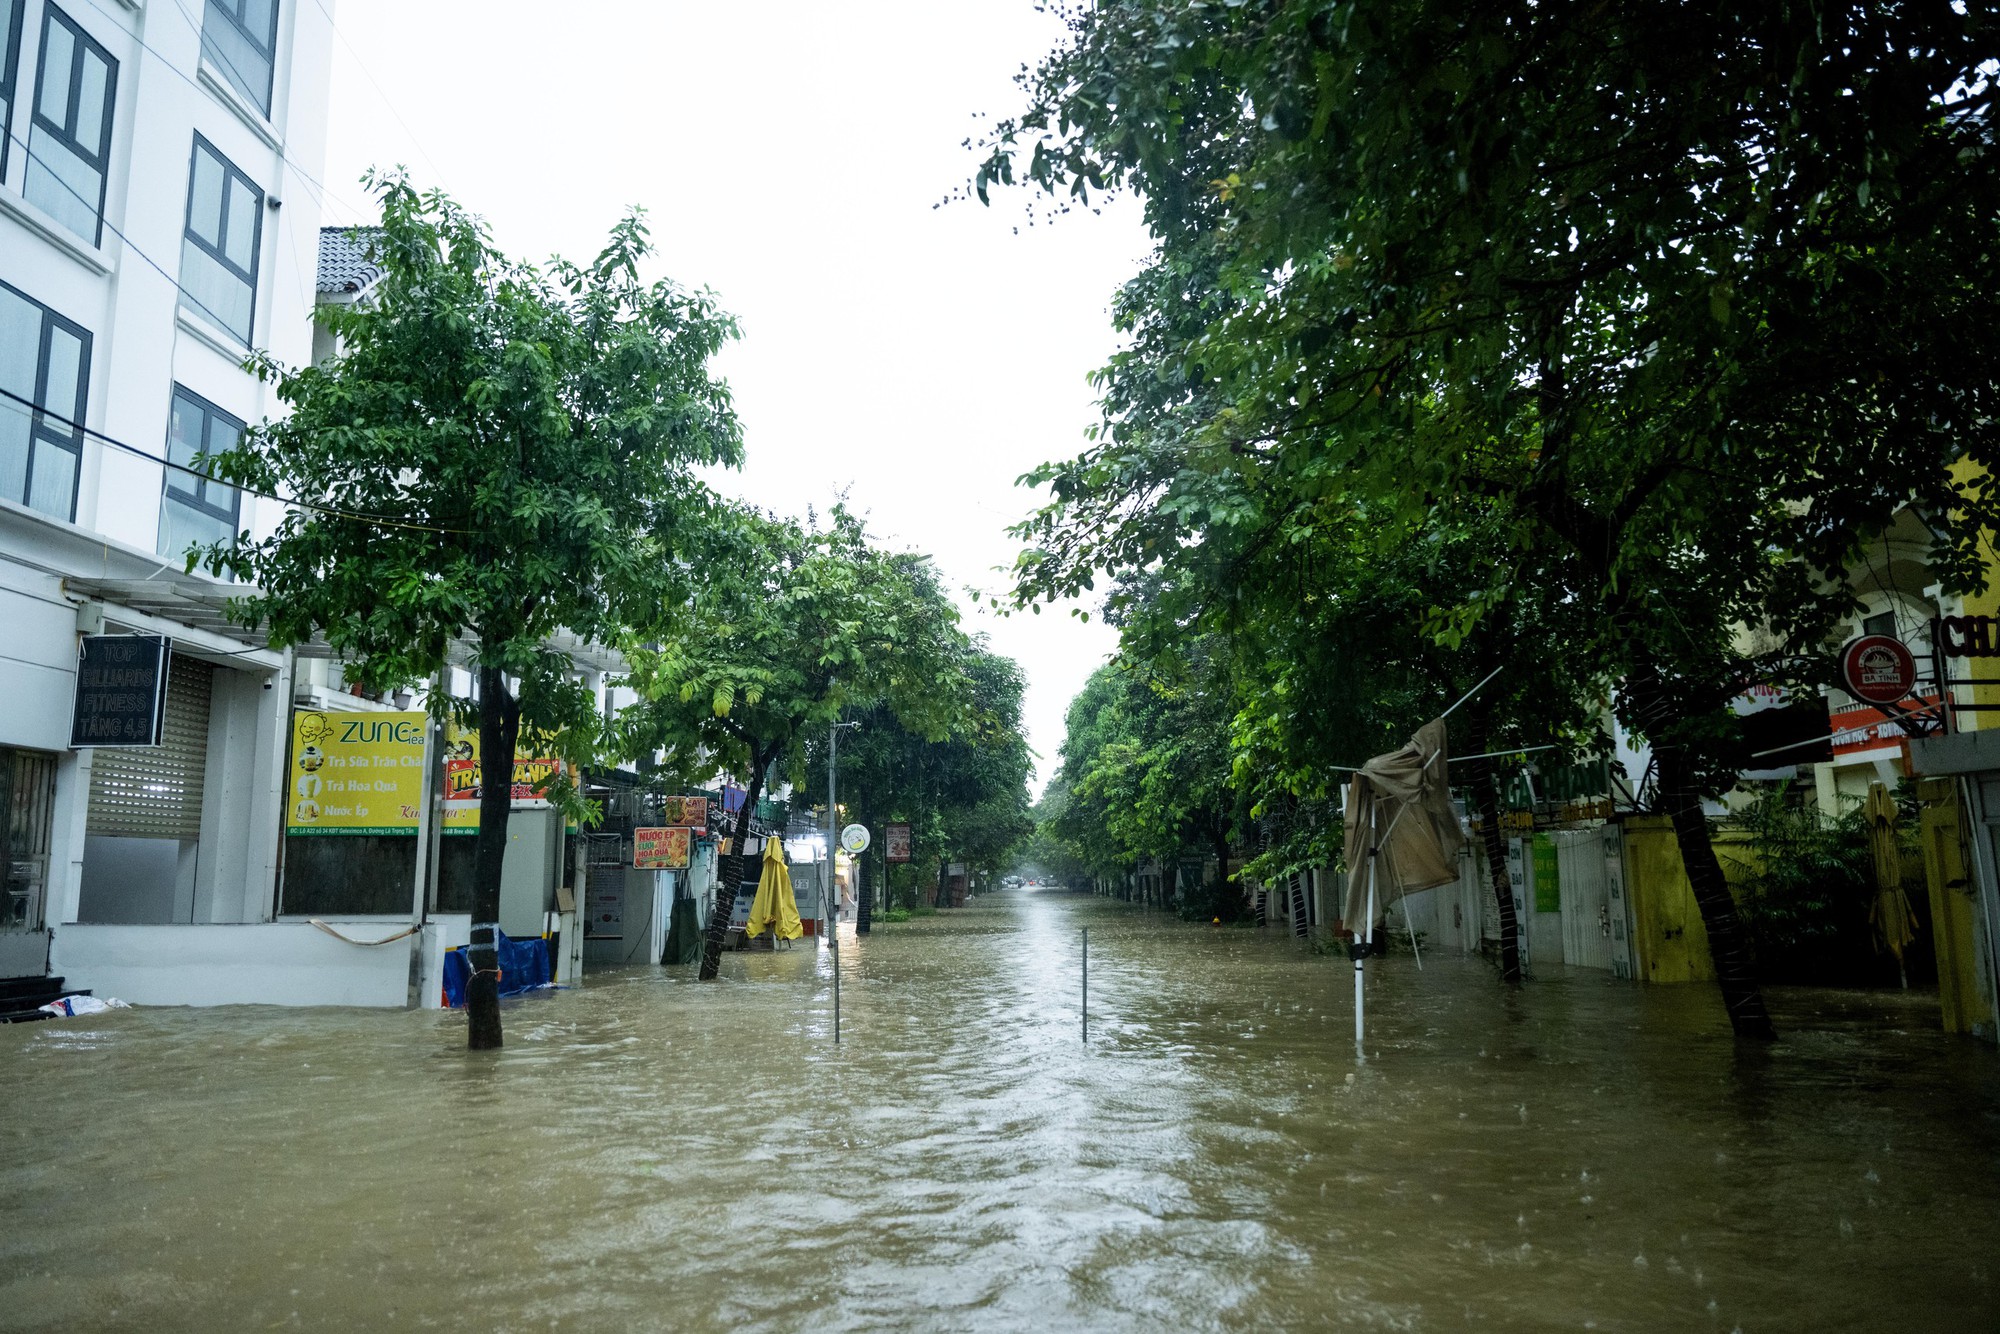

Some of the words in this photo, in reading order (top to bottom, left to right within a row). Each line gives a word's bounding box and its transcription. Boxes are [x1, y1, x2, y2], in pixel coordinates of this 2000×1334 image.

[1939, 615, 2000, 658] CH
[103, 644, 138, 662] TOP
[82, 668, 153, 687] BILLIARDS
[83, 693, 147, 712] FITNESS
[124, 718, 147, 739] 4,5
[328, 755, 346, 767] Trà
[349, 755, 369, 767] Sữa
[372, 755, 397, 767] Trân
[326, 780, 345, 792] Trà
[347, 780, 371, 792] Hoa
[373, 780, 397, 793] Quả
[324, 804, 353, 816] Nước
[355, 803, 369, 817] Ép
